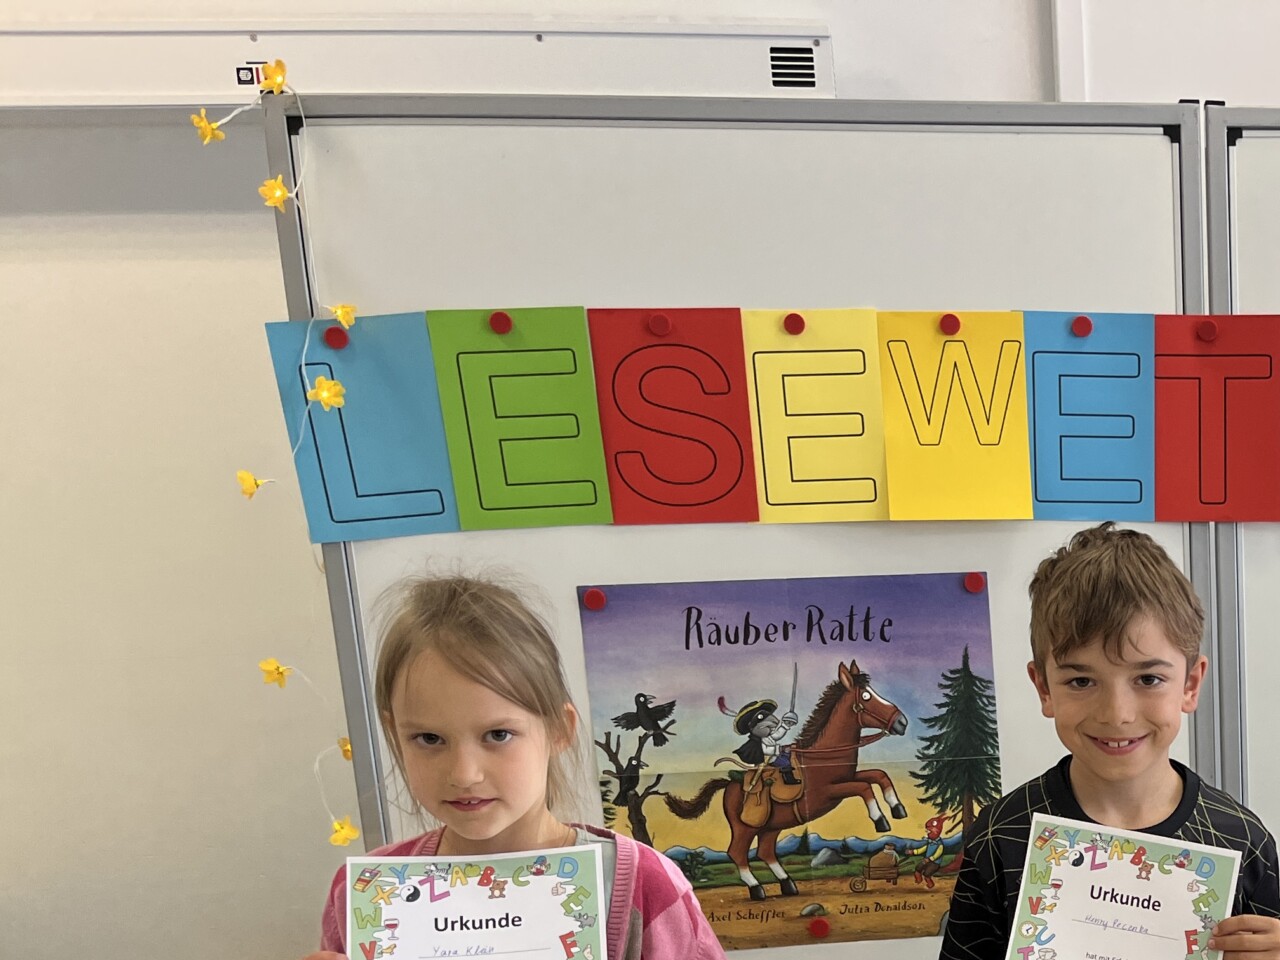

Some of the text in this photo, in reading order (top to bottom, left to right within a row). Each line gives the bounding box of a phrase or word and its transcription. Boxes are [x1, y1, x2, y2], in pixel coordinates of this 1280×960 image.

[682, 605, 892, 650] Räuber Ratte
[1045, 845, 1069, 866] X
[1063, 829, 1215, 879] Y Z A B C D
[389, 857, 579, 902] Y Z A B C D
[1030, 864, 1053, 885] W
[371, 885, 399, 905] X
[561, 886, 592, 914] E
[1090, 885, 1161, 911] Urkunde
[1192, 889, 1219, 912] E
[708, 910, 785, 923] Axel Scheffler
[840, 901, 926, 915] Julia Donaldson
[1028, 897, 1042, 916] V
[354, 907, 382, 929] W
[434, 913, 523, 932] Urkunde
[559, 931, 580, 959] F
[1035, 925, 1055, 945] U
[1185, 929, 1198, 954] F
[359, 941, 377, 960] V
[1086, 952, 1097, 960] hat
